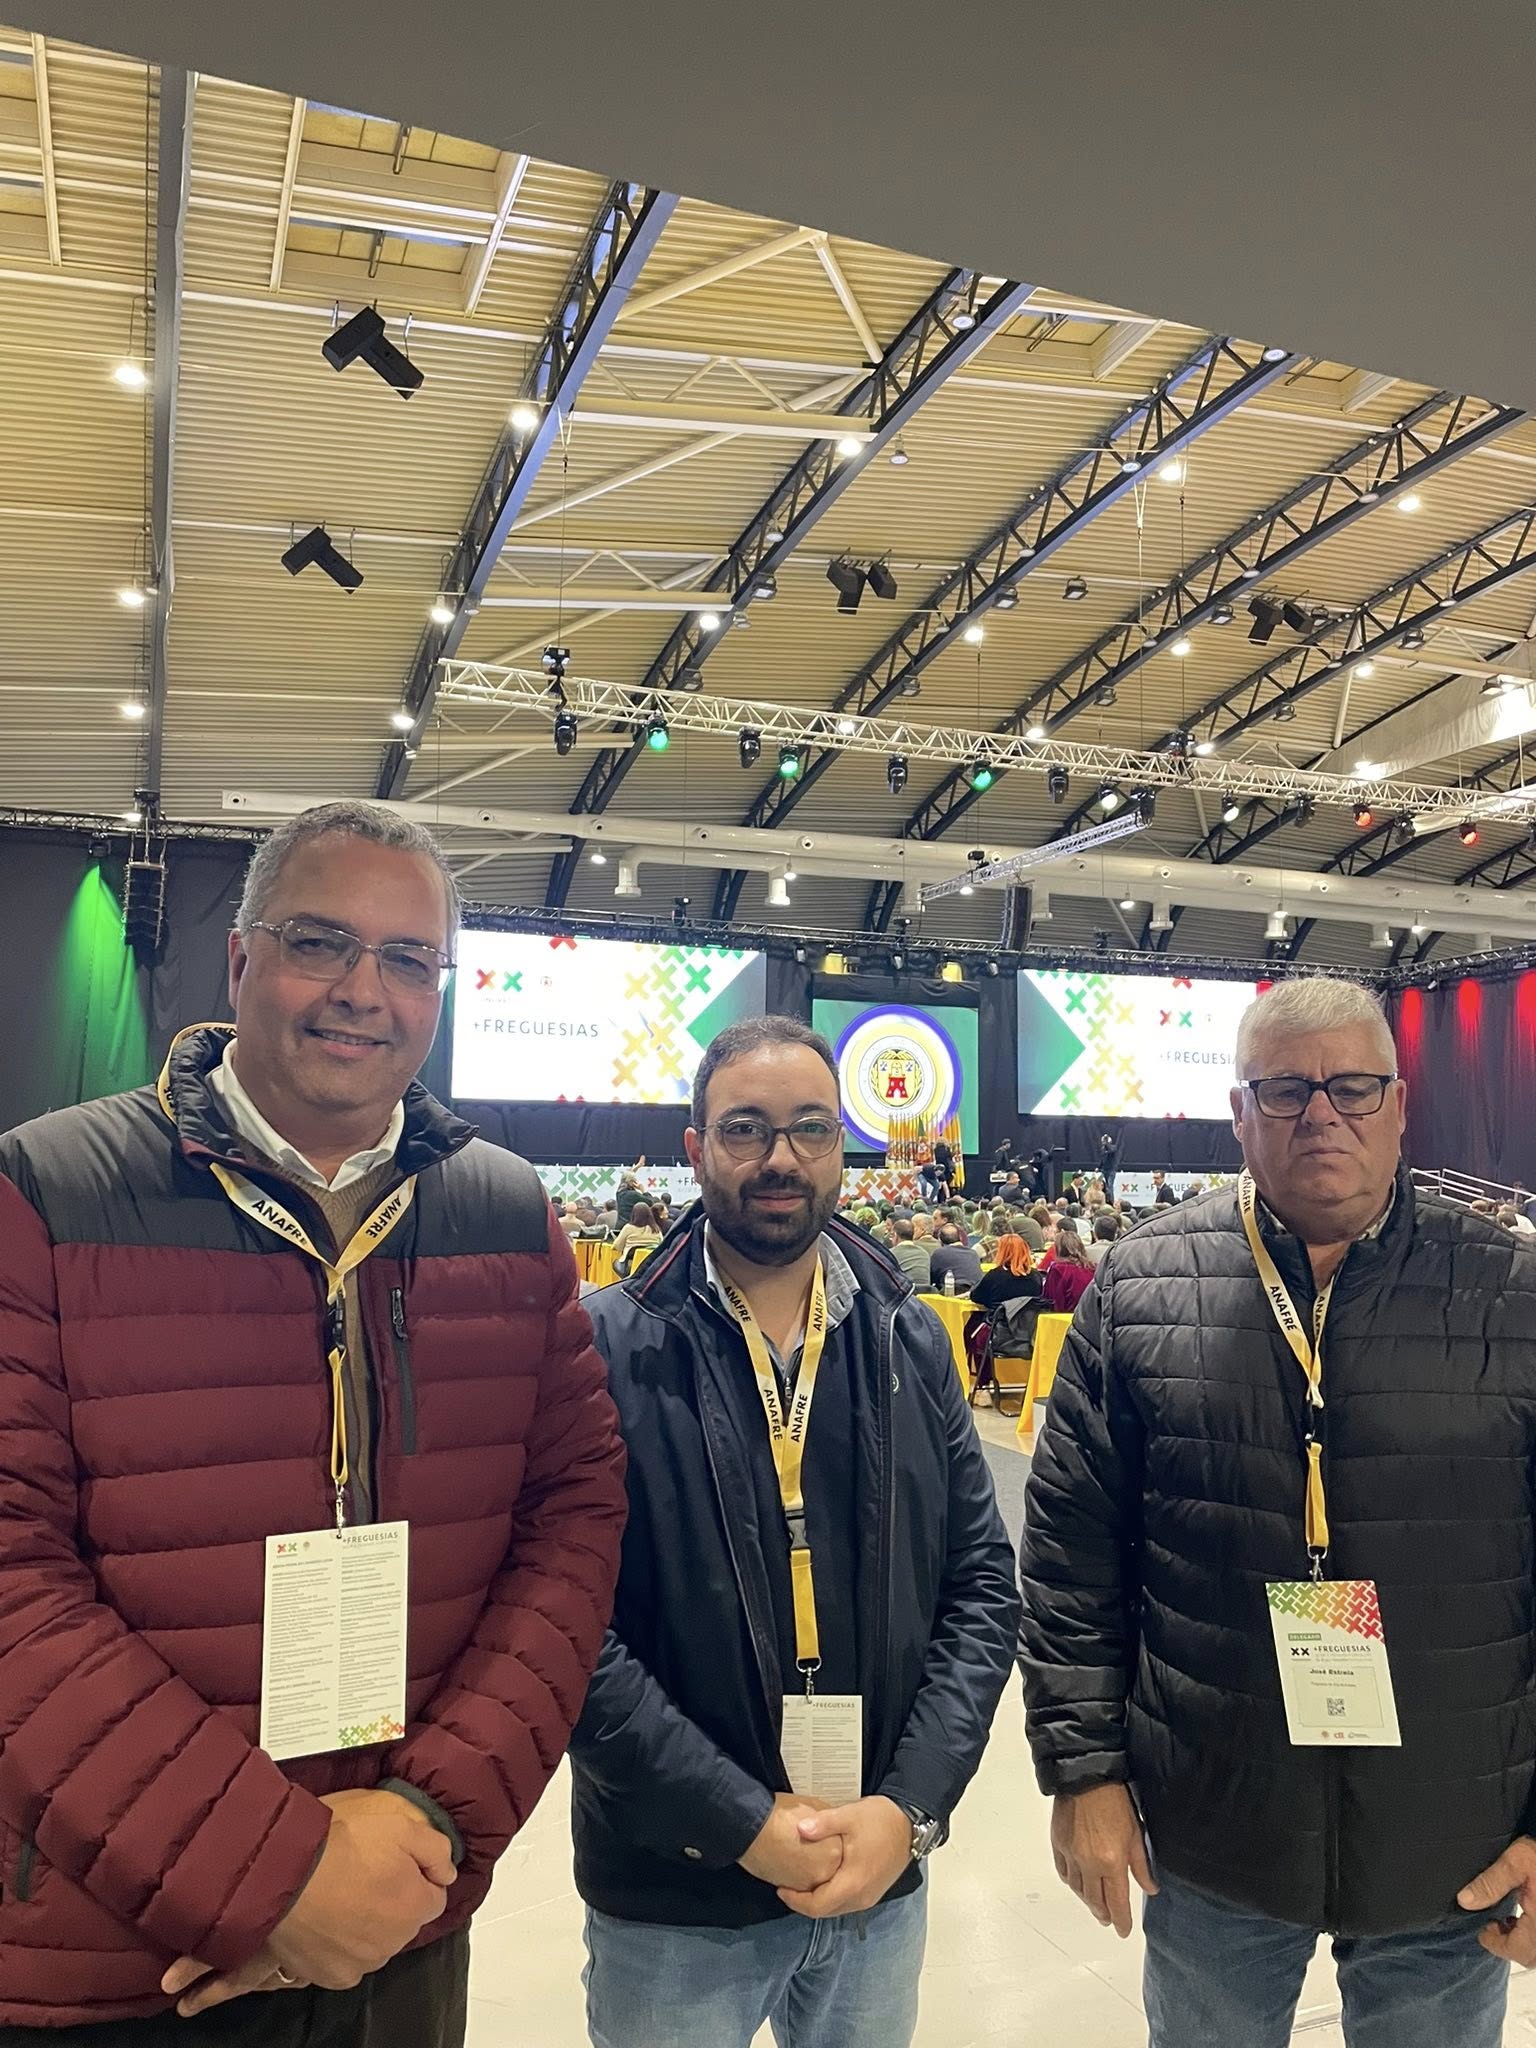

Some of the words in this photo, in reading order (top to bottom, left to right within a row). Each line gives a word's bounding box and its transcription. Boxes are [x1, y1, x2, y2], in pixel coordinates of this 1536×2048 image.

[473, 1019, 599, 1038] +FREGUESIAS
[251, 1199, 308, 1245] ANAFRE
[365, 1195, 402, 1238] ANAFRE
[724, 1285, 752, 1323] ANAFRE
[1270, 1286, 1297, 1331] ANAFRE
[764, 1388, 782, 1441] ANAFRE
[790, 1393, 808, 1443] ANAFRE
[342, 1531, 399, 1545] +FREGUESIAS
